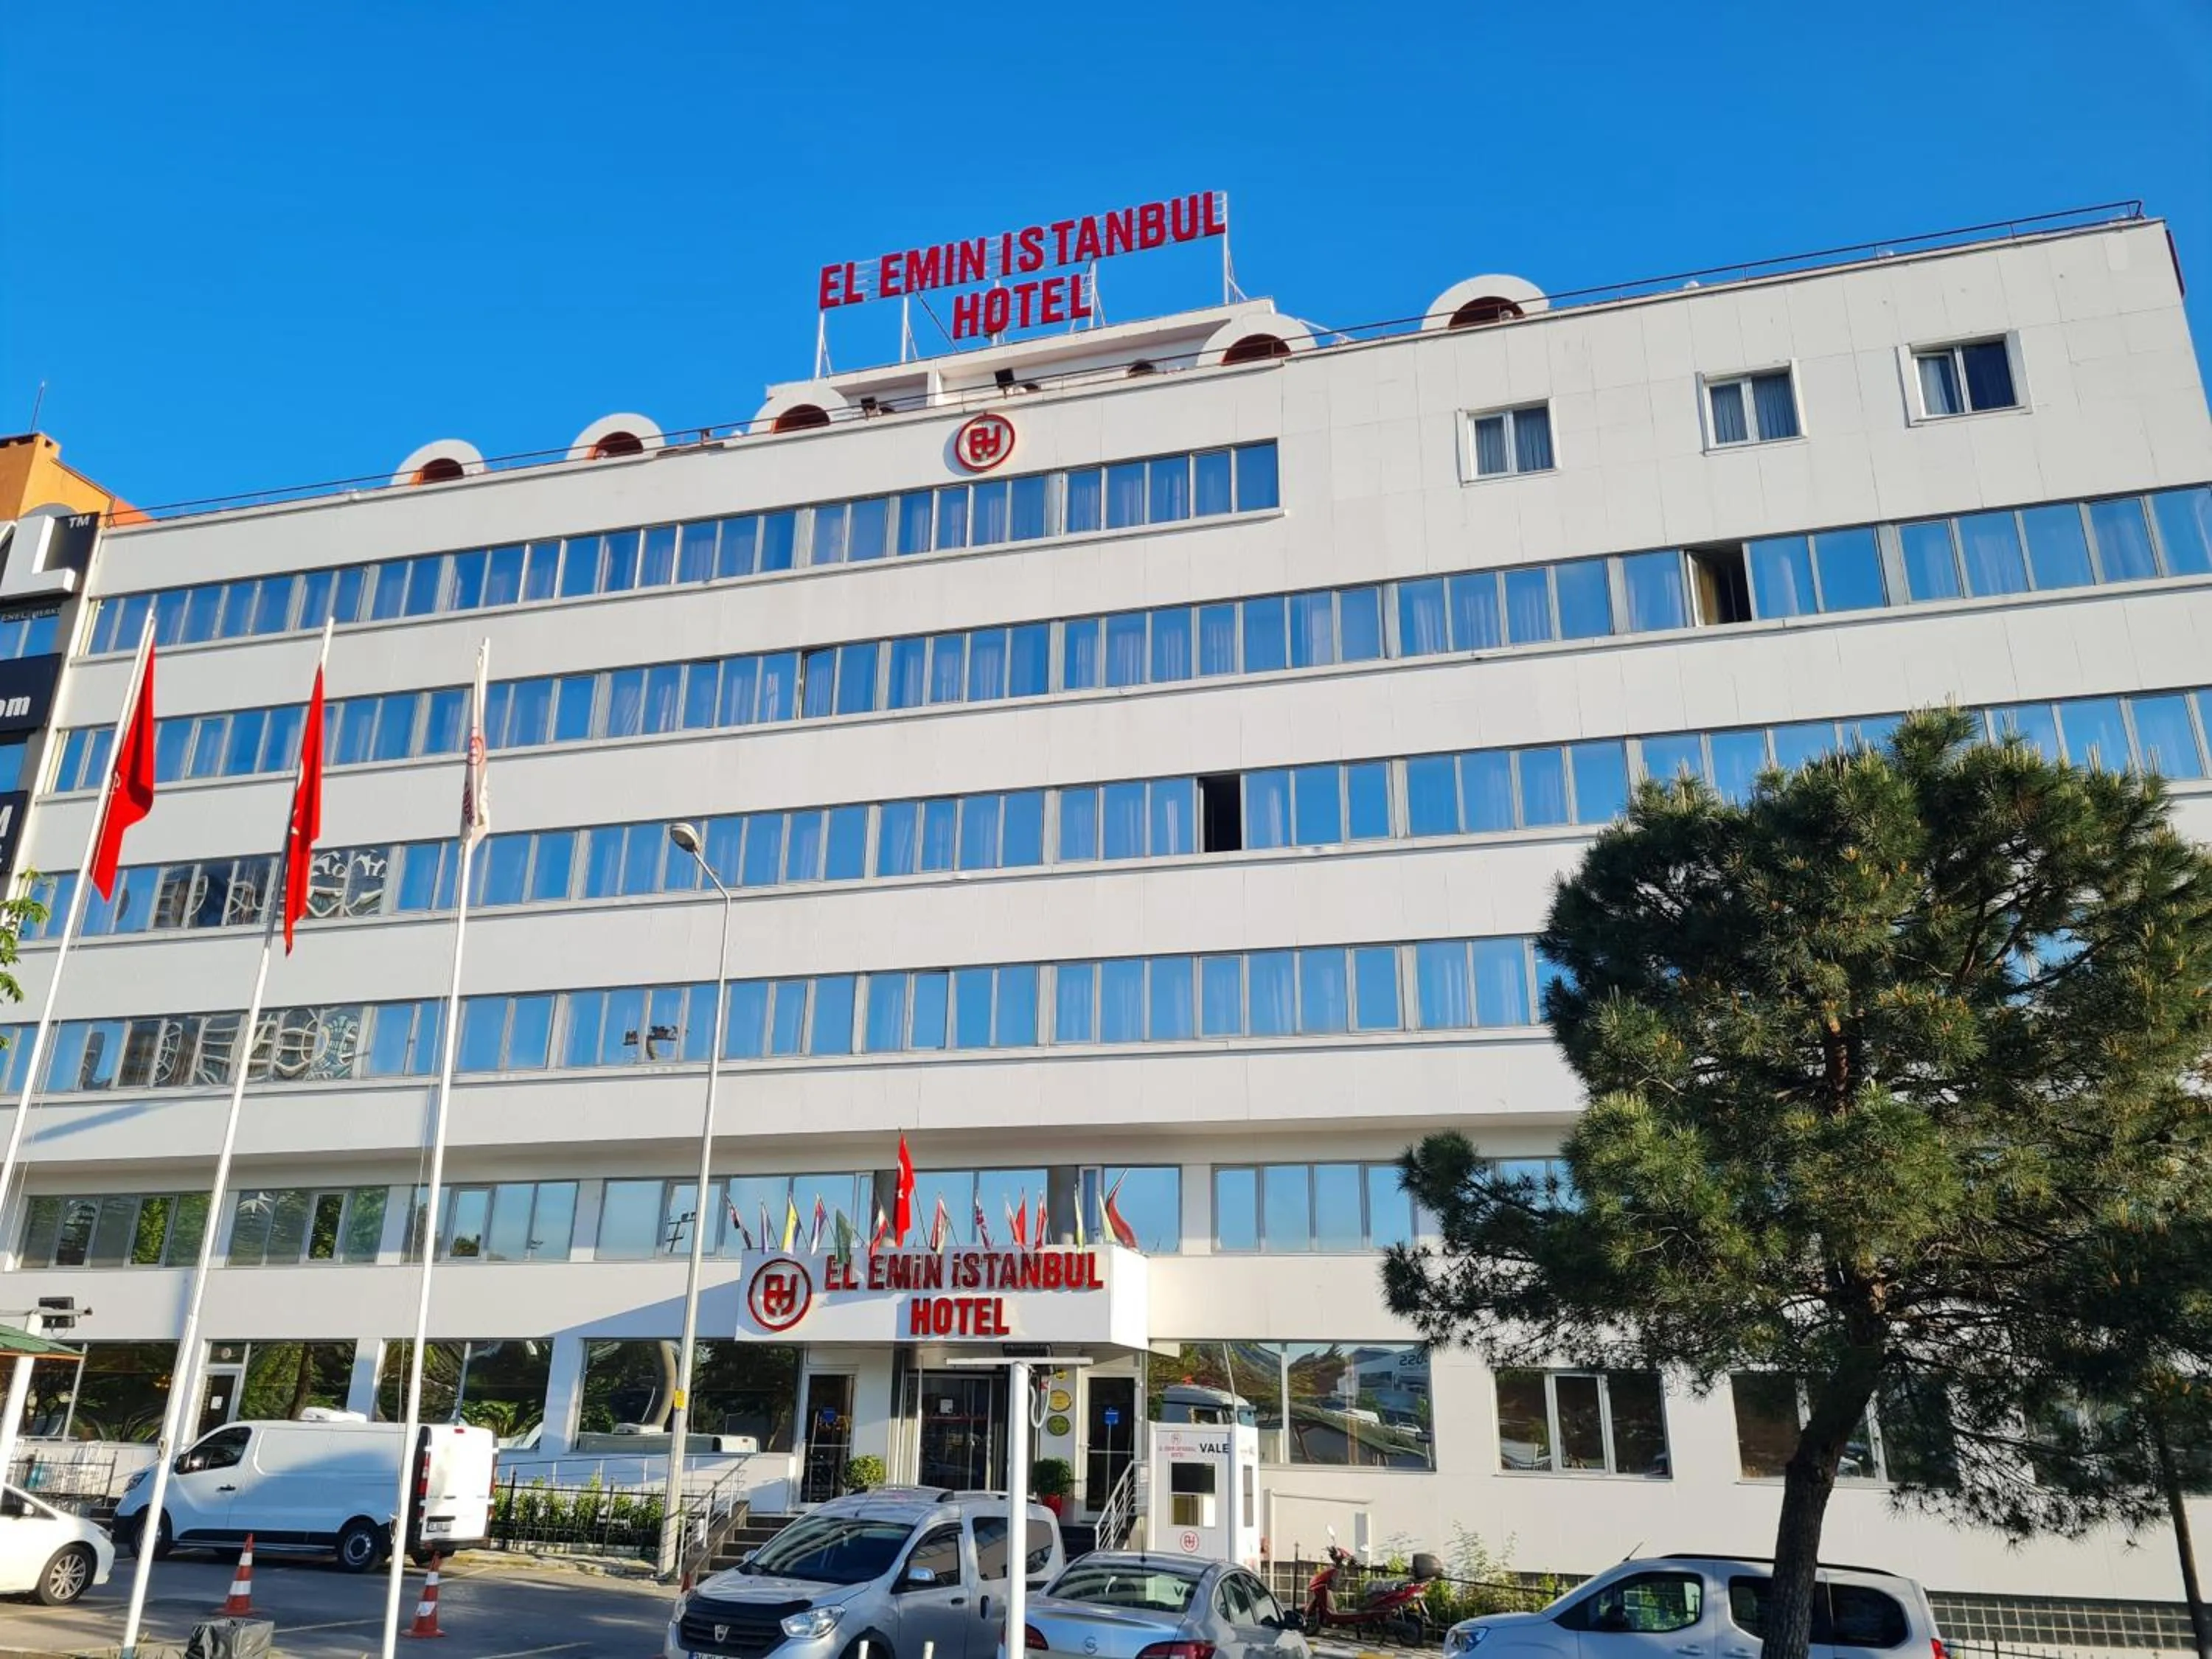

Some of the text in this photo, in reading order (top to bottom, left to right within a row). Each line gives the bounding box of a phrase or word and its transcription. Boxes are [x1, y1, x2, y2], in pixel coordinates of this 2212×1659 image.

[820, 191, 1225, 310] EL EMIN ISTANBUL
[953, 274, 1091, 338] HOTEL
[824, 1254, 858, 1290] EL
[909, 1297, 1010, 1336] HOTEL
[1200, 1442, 1230, 1454] VALE
